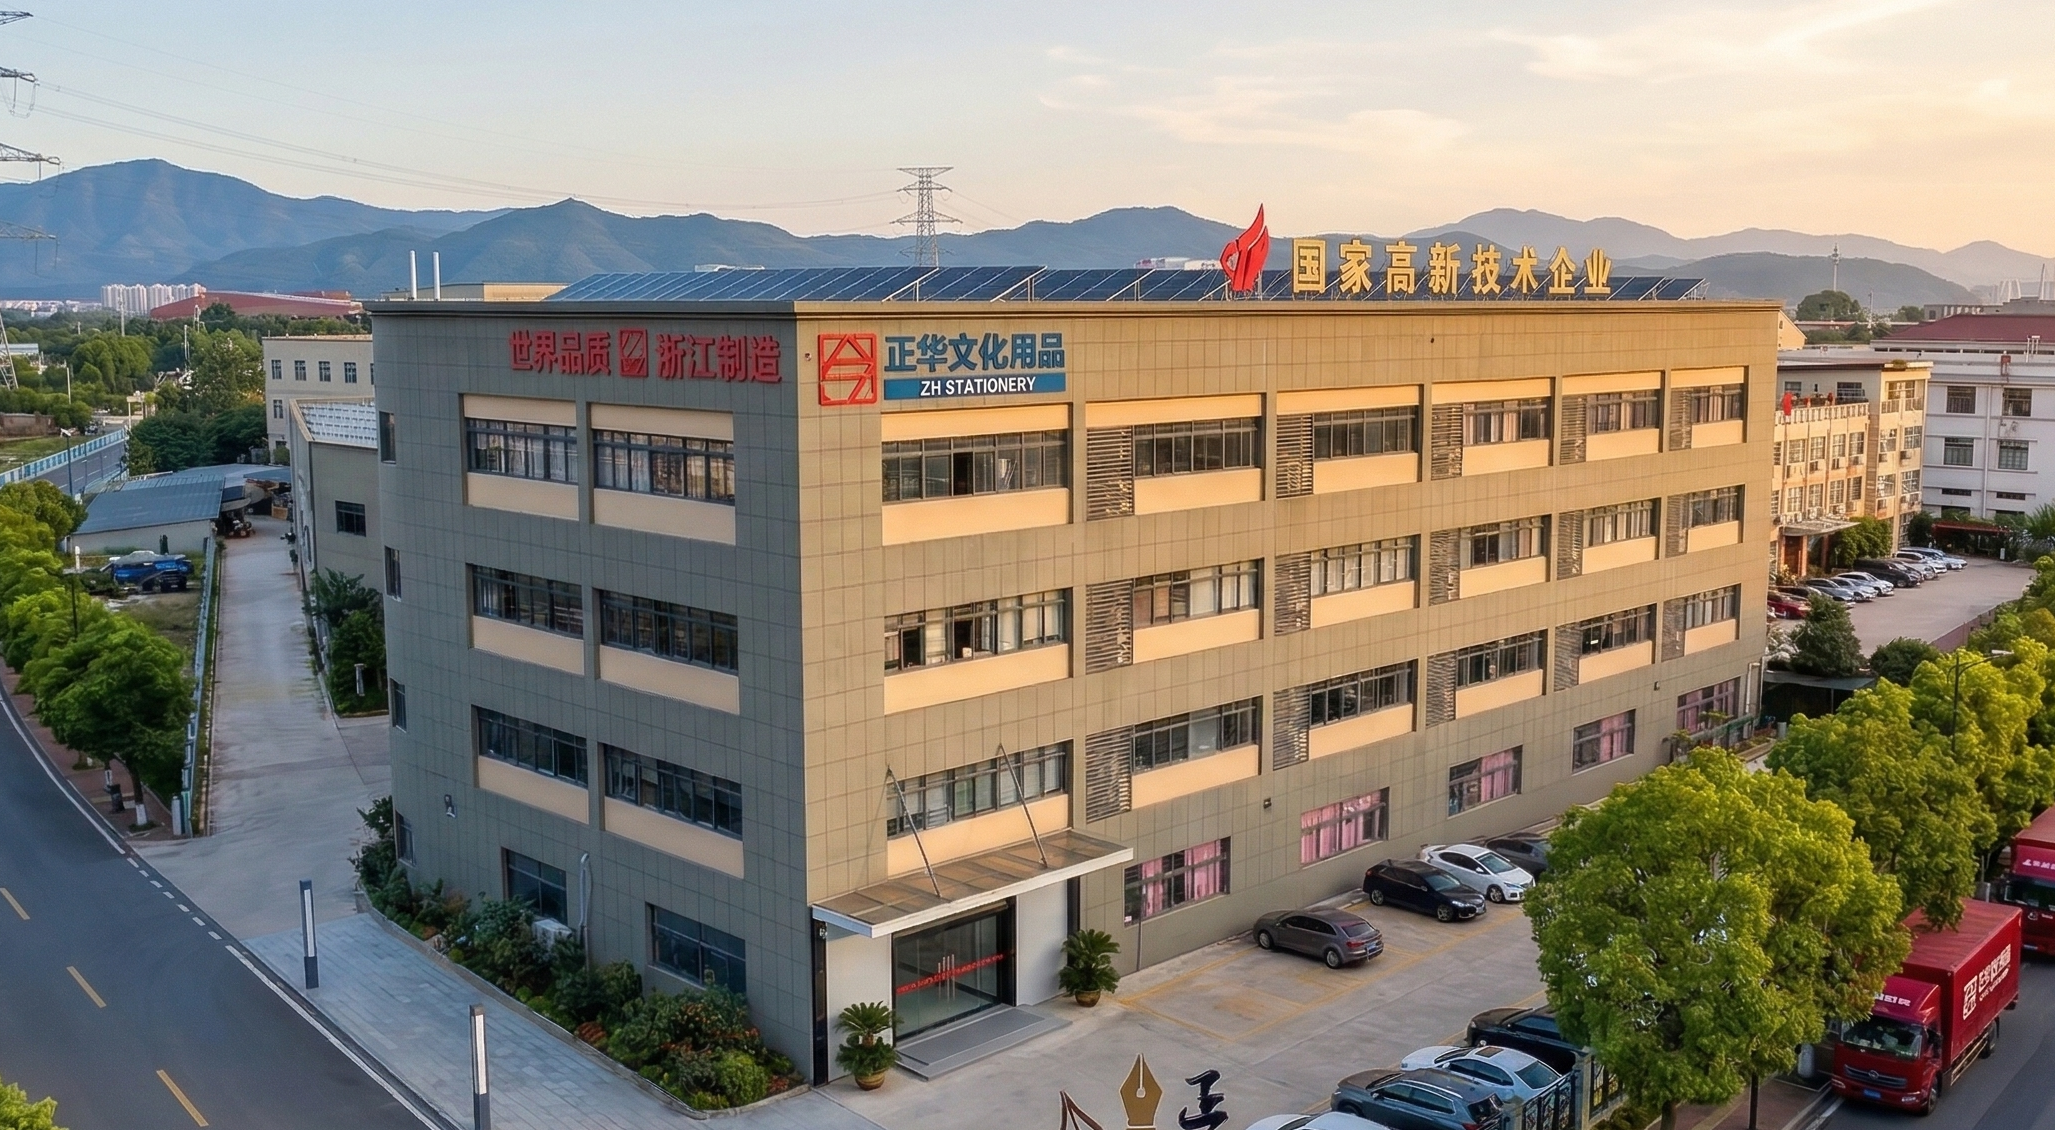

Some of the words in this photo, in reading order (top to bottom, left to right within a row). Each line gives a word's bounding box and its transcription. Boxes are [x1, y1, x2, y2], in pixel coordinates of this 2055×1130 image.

[1293, 238, 1612, 294] 国家高新技术企业
[509, 329, 611, 376] 世界品质
[656, 333, 782, 384] 浙江制造
[884, 332, 1065, 373] 正华文化用品
[920, 381, 941, 396] ZH
[944, 376, 1036, 395] STATIONERY
